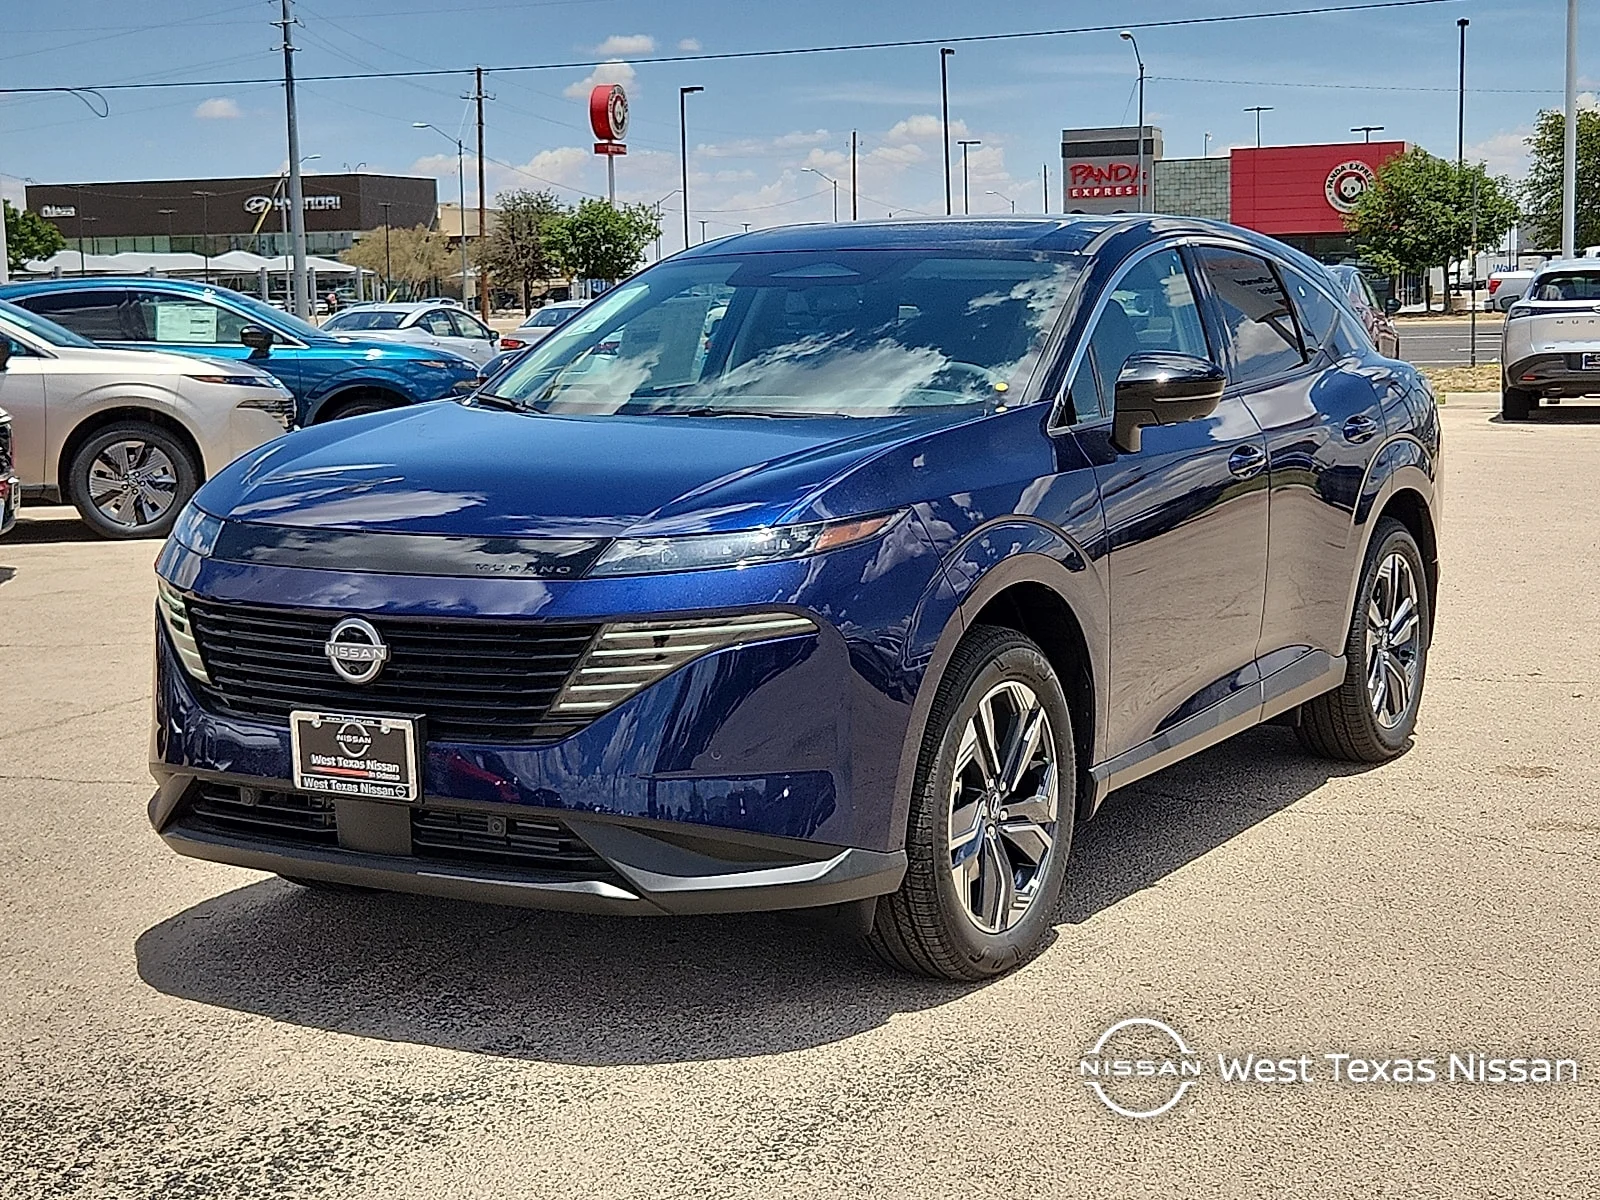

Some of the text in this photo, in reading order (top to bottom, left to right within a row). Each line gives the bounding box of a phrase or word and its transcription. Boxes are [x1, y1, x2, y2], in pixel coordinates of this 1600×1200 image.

[1326, 165, 1347, 189] PANDA
[1071, 186, 1140, 197] EXPRES
[475, 563, 571, 575] MURANO
[326, 644, 385, 658] NISSAN
[336, 734, 372, 744] NISSAN
[310, 754, 400, 773] West Texas Nissan
[303, 777, 395, 796] West Texas Nissan
